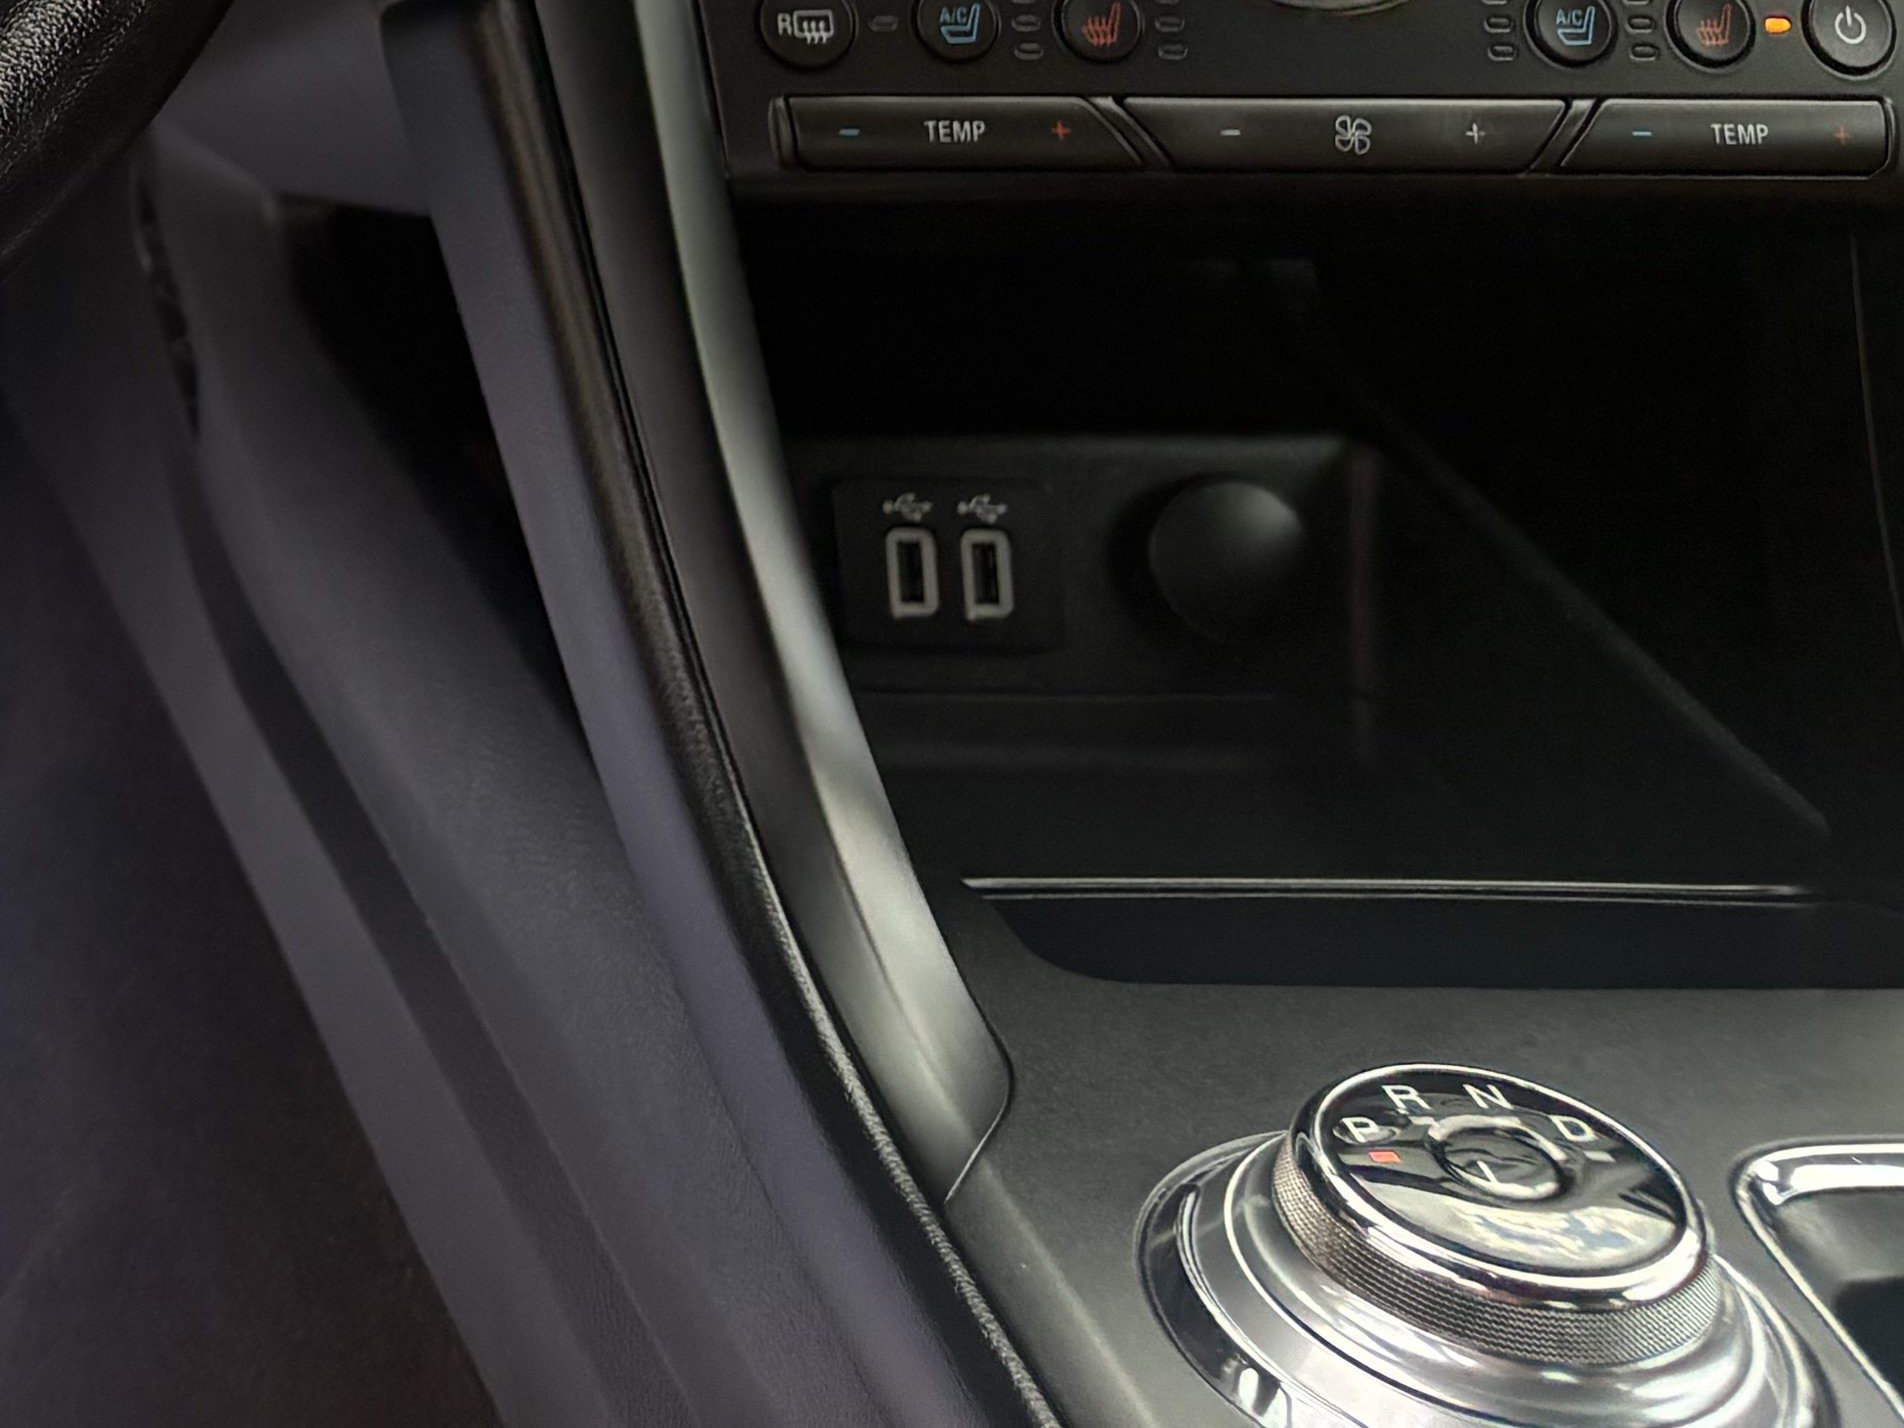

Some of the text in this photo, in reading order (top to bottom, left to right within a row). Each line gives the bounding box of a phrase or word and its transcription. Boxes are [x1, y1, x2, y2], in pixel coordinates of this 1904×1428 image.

[776, 15, 792, 37] R
[939, 5, 969, 25] A/C
[1555, 8, 1584, 27] A/C
[923, 119, 986, 144] TEMP
[1709, 122, 1770, 146] TEMP
[1342, 1083, 1598, 1143] P R N D
